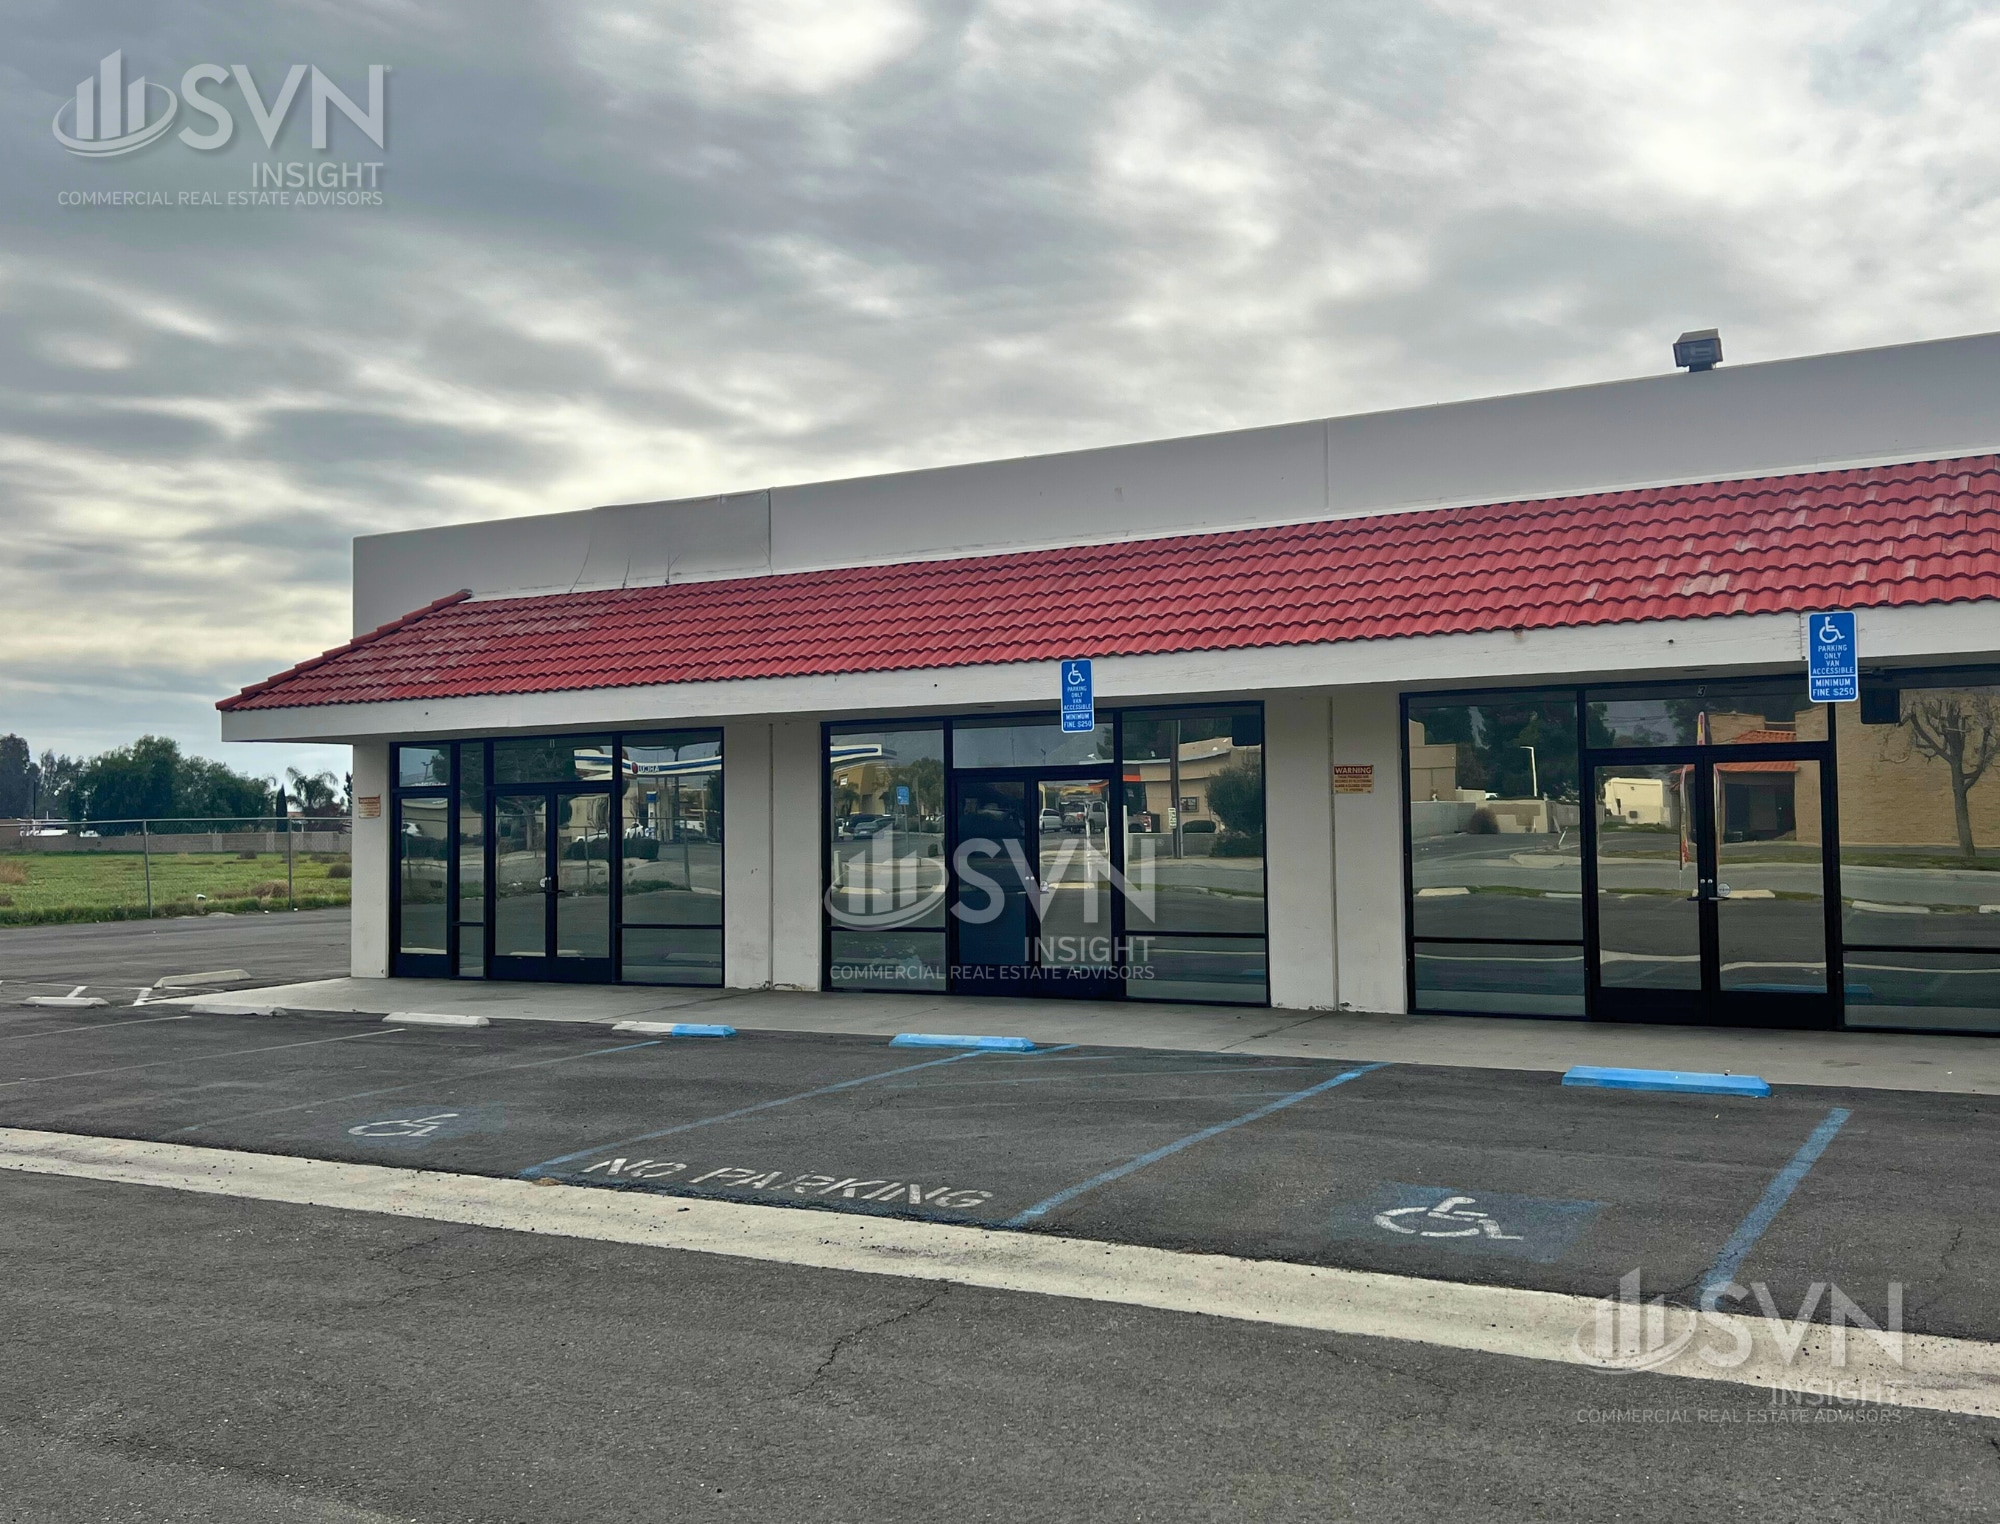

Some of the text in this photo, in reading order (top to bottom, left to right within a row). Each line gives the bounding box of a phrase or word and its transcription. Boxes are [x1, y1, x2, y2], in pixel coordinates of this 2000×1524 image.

[1818, 644, 1848, 652] PARKING
[1816, 678, 1850, 686] MINIMUM
[1813, 688, 1830, 697] FINE
[582, 1158, 994, 1208] NO PARKING
